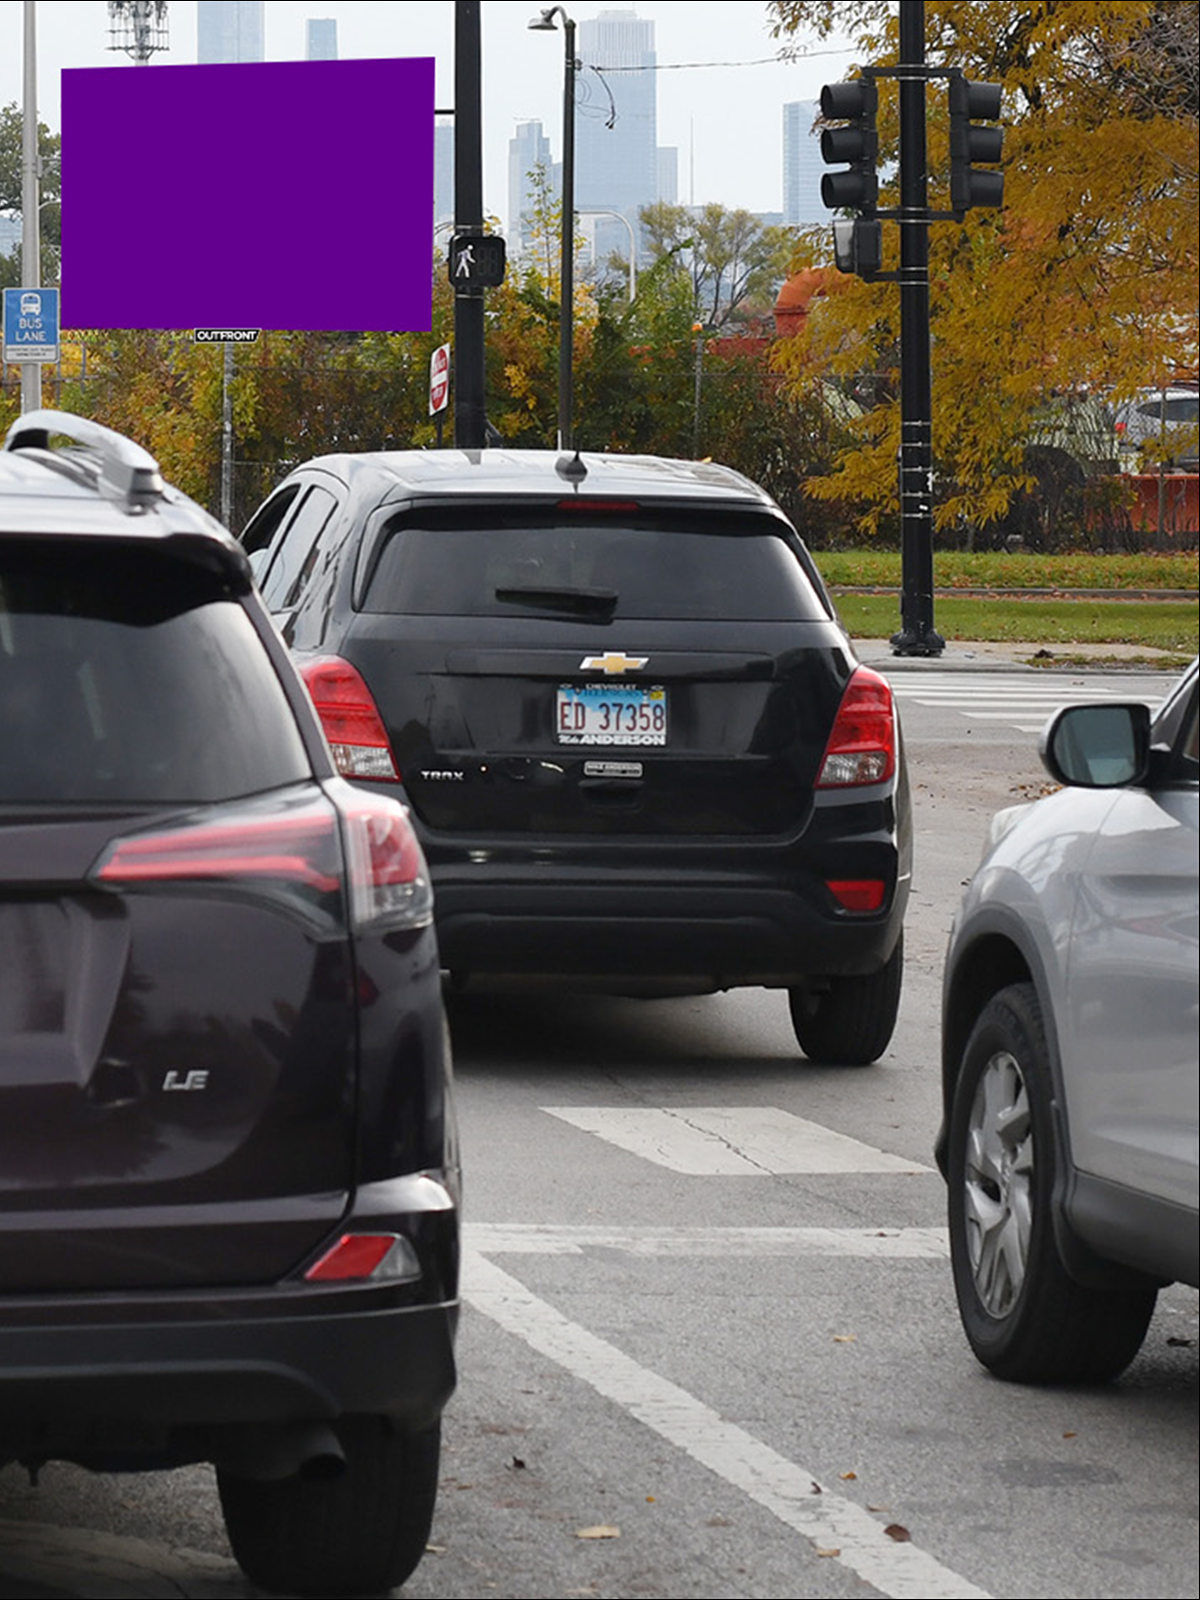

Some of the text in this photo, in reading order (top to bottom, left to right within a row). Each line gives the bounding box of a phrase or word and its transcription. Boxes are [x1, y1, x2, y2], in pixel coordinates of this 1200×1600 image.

[19, 318, 42, 329] BUS
[15, 331, 47, 342] LANE
[197, 331, 257, 341] OUTFRONT
[560, 702, 664, 731] ED 37358
[580, 734, 666, 746] ANDERSON
[420, 770, 464, 780] TRAX
[162, 1070, 209, 1090] LE
